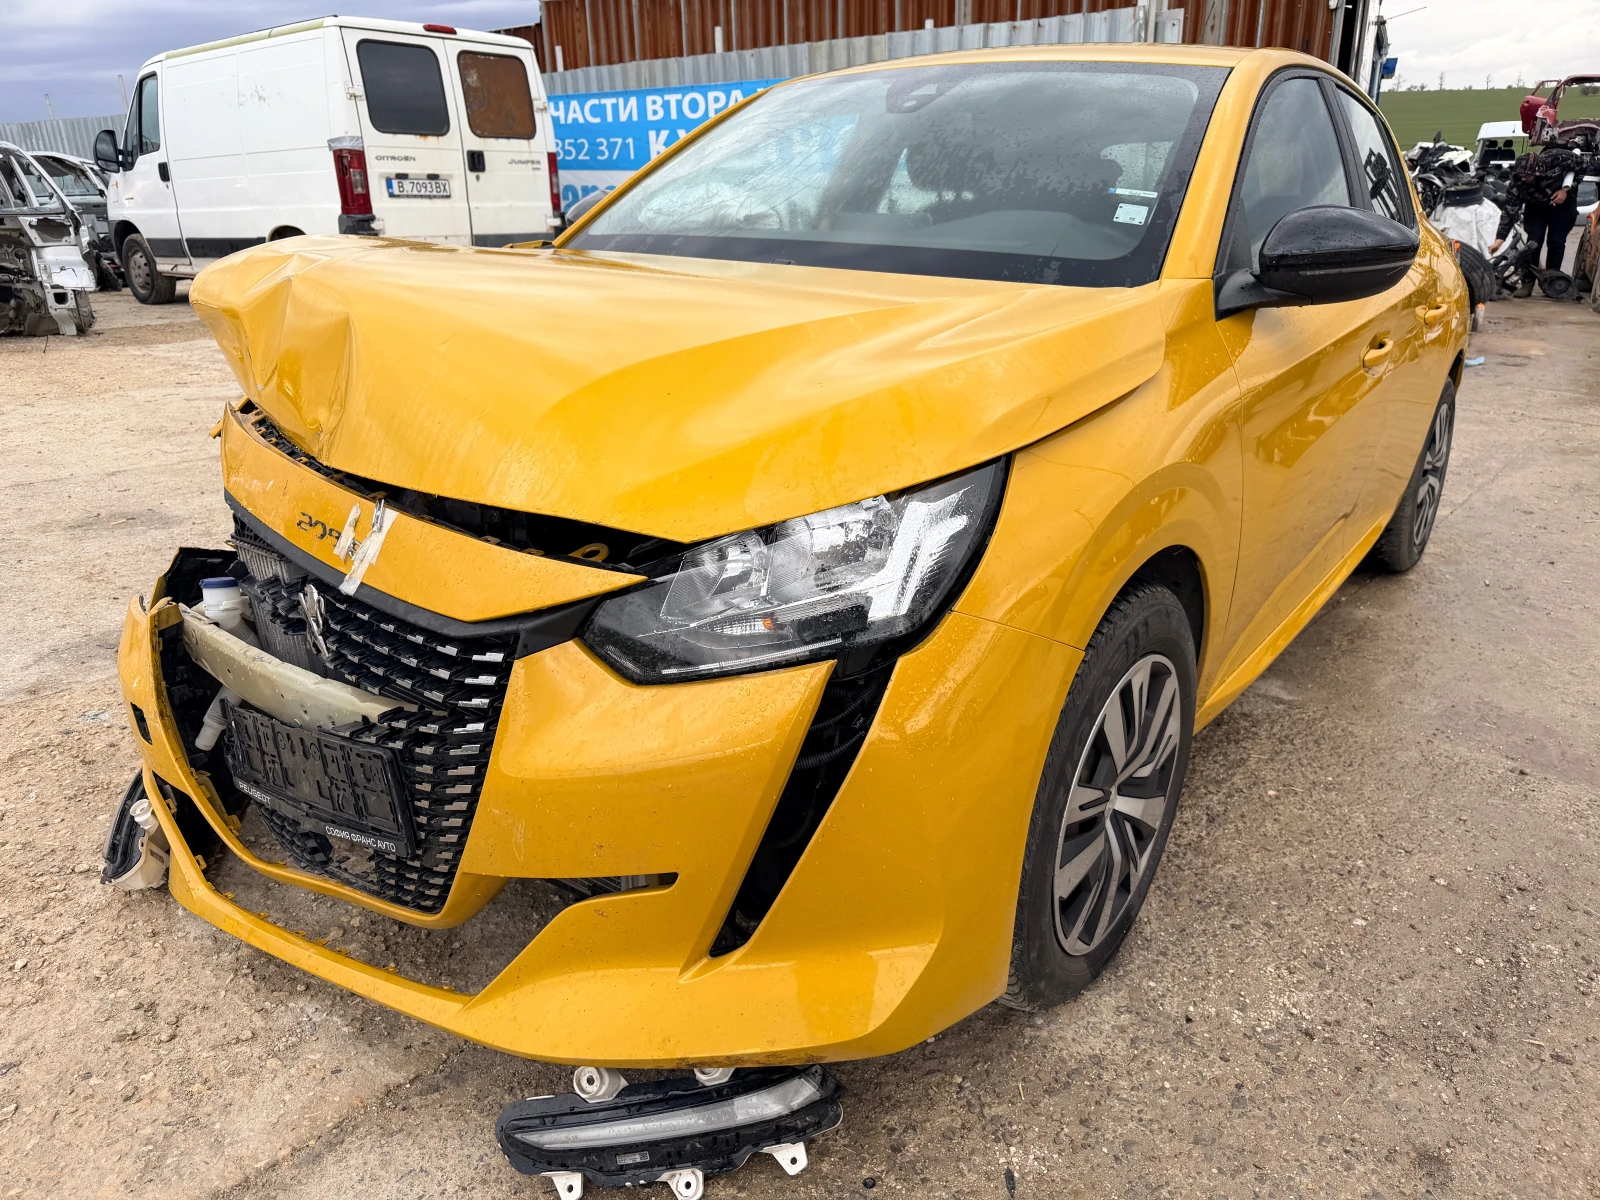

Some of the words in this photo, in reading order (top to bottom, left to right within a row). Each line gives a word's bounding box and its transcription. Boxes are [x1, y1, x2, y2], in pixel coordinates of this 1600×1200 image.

[549, 95, 639, 124] ЧАСТИ
[596, 137, 635, 161] 371
[238, 781, 271, 805] PEUGEOT
[325, 825, 350, 840] СОФИЯ
[351, 833, 377, 848] ФРАНС
[377, 840, 396, 852] АУТО
